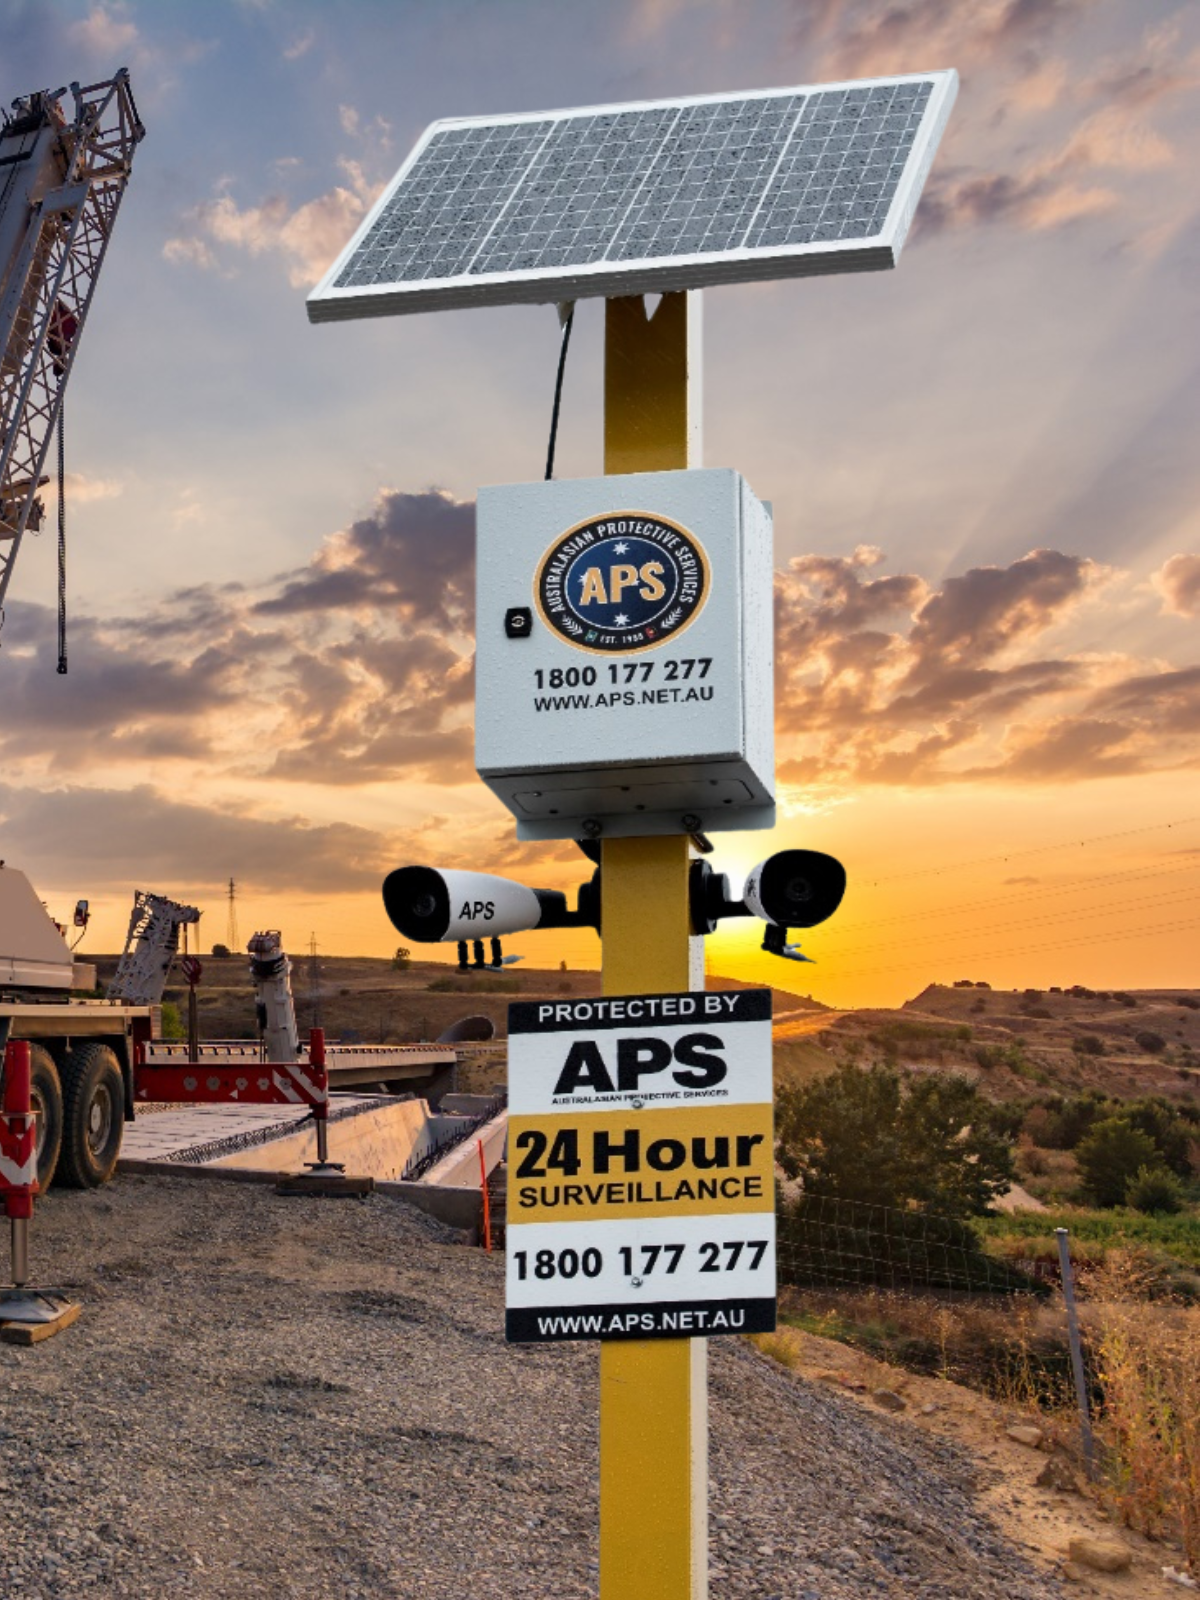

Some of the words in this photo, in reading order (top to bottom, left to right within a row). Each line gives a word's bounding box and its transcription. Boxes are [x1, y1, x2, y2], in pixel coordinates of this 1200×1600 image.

[546, 531, 595, 613] AUSTRALASIAN
[597, 521, 681, 549] PROTECTIVE
[675, 546, 698, 603] SERVICES
[579, 560, 666, 606] APS
[534, 666, 597, 690] 1800
[608, 662, 655, 684] 177
[664, 658, 712, 681] 277
[534, 686, 714, 712] WWW.APS.NET.AU
[458, 901, 495, 920] APS
[538, 997, 696, 1023] PROTECTED
[704, 995, 740, 1014] BY
[553, 1032, 727, 1095] APS
[683, 1089, 728, 1099] SERVICES
[516, 1129, 581, 1179] 24
[593, 1129, 764, 1174] Hour
[518, 1176, 763, 1208] SURVEILLANCE
[514, 1247, 603, 1281] 1800
[619, 1243, 686, 1276] 177
[698, 1240, 769, 1273] 277
[538, 1309, 746, 1335] WWW.APS.NET.AU
